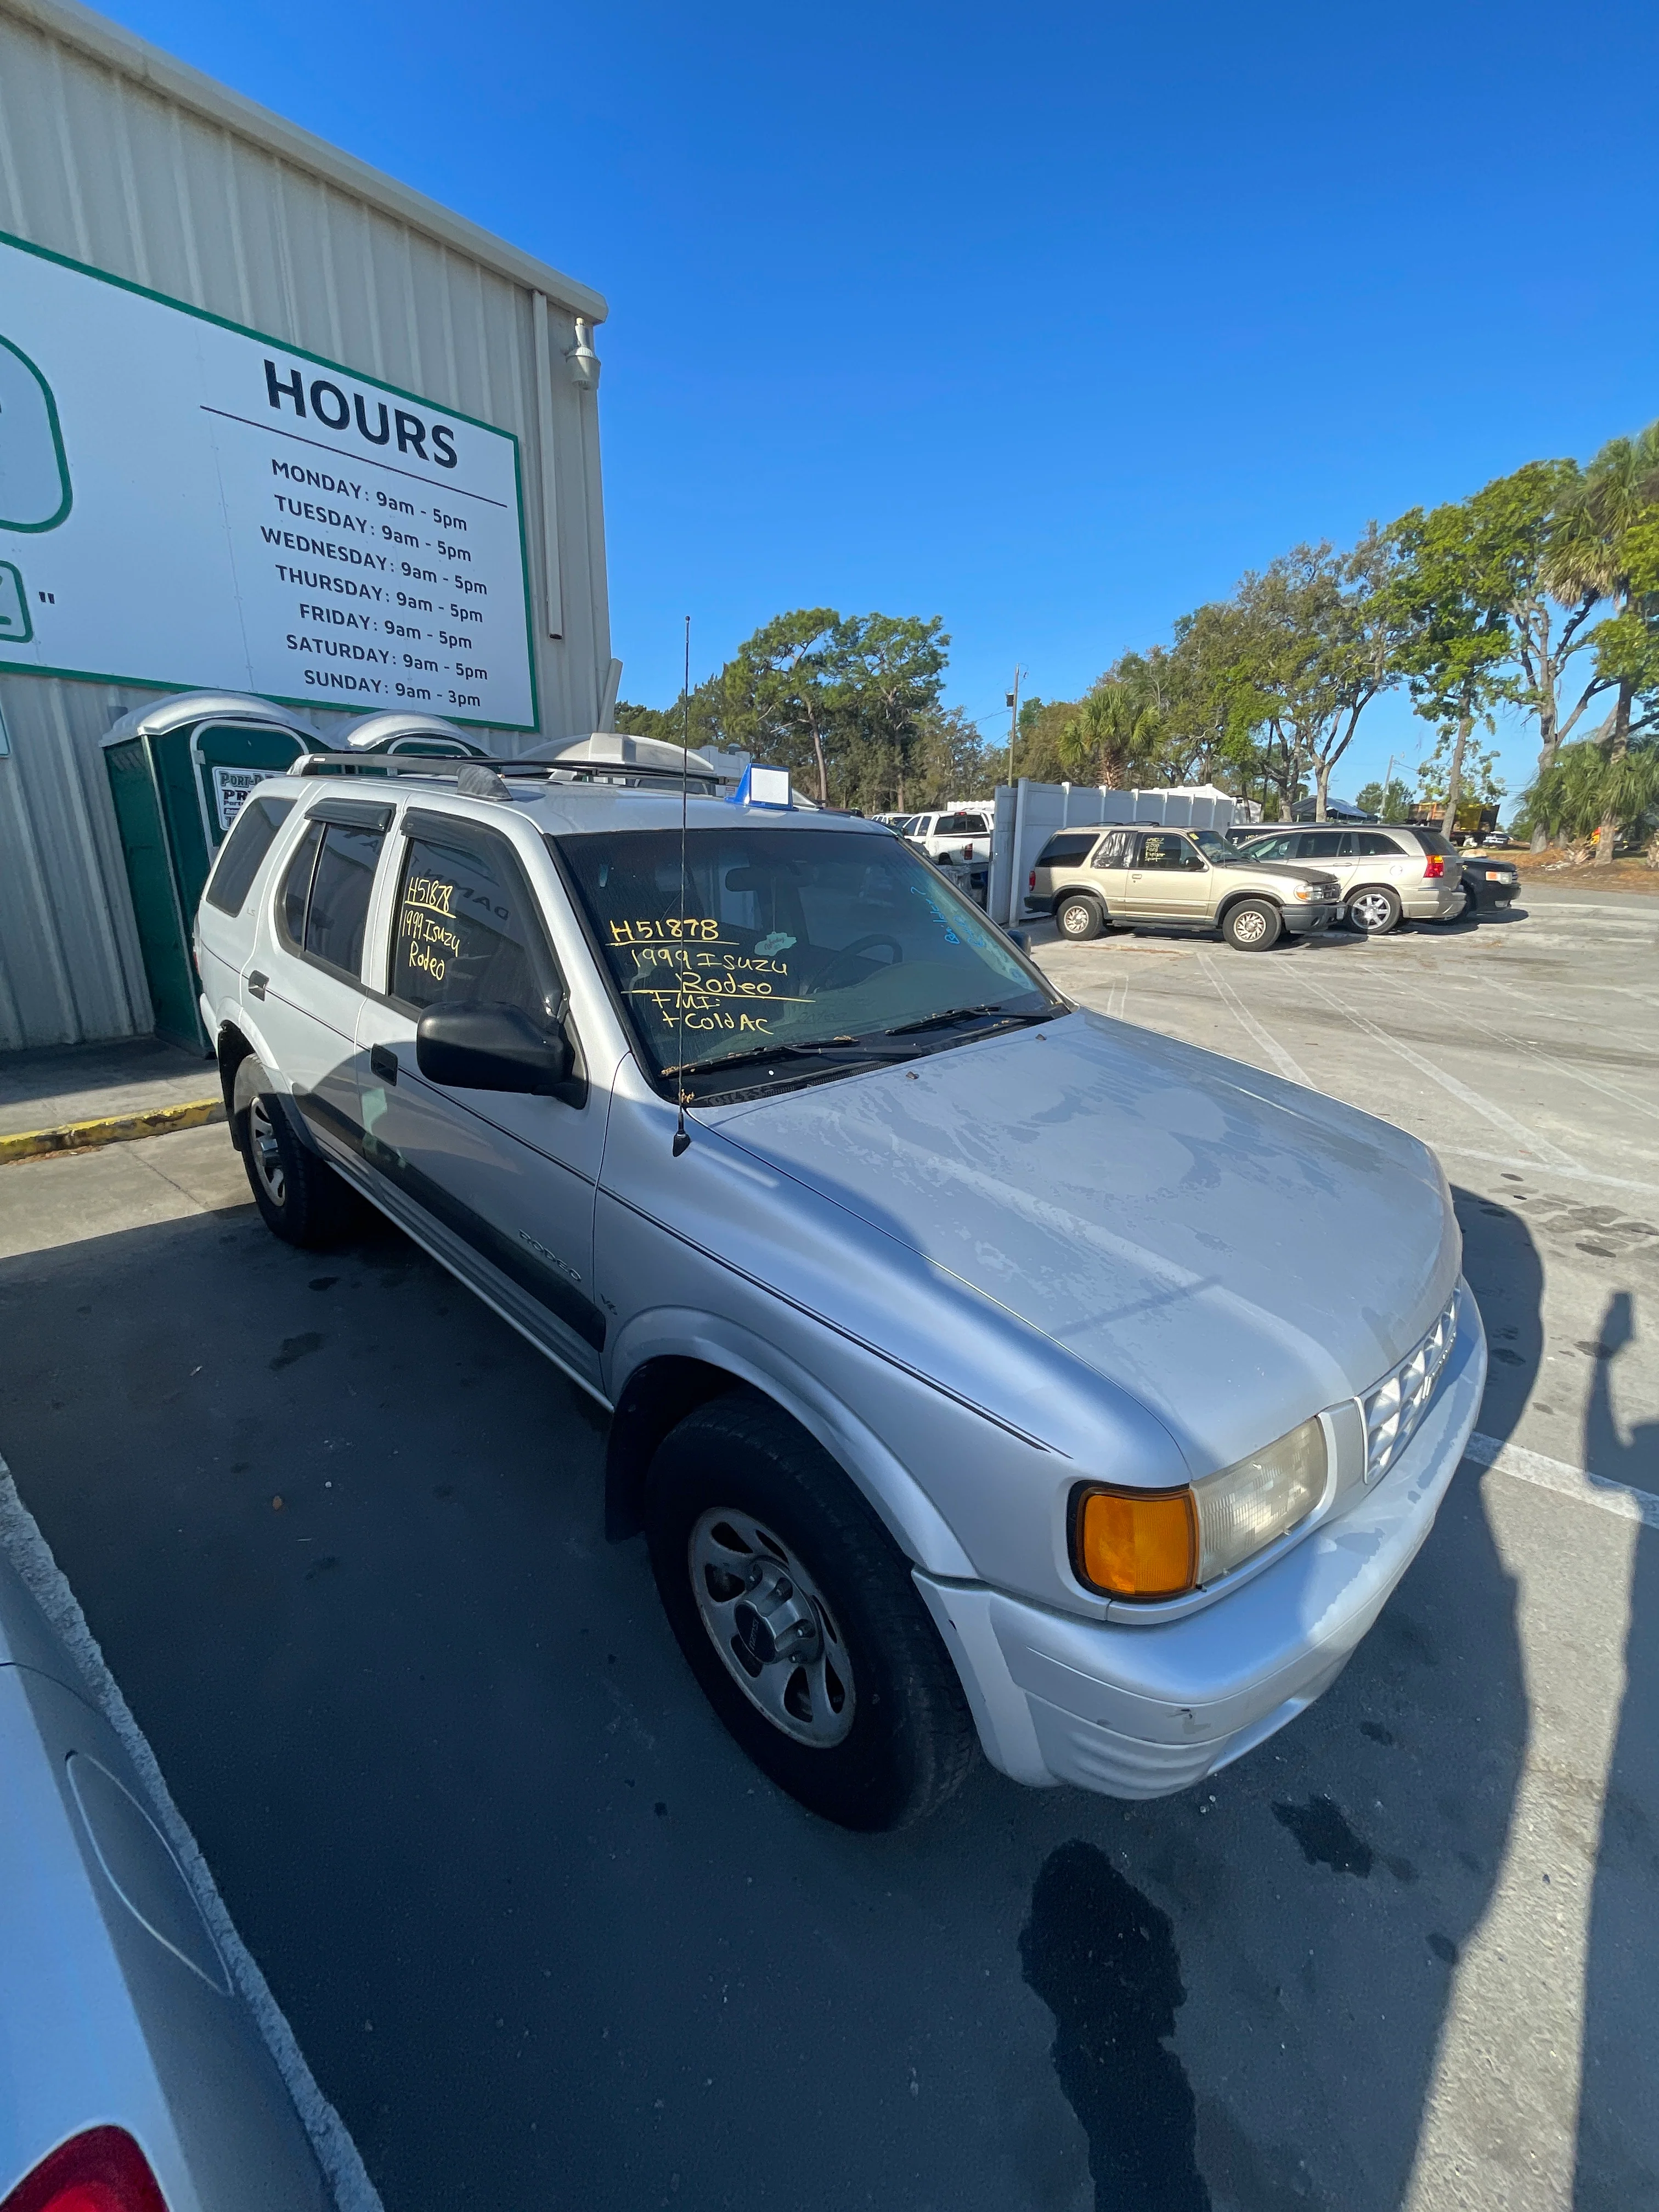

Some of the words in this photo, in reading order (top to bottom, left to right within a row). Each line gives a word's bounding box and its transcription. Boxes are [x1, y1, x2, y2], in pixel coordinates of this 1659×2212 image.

[263, 359, 458, 469] HOURS
[272, 459, 369, 501] MONDAY:
[376, 492, 414, 516] 9am
[433, 509, 467, 531] 5pm
[274, 494, 375, 536] TUESDAY:
[382, 525, 419, 548] 9am
[437, 540, 471, 562] 5pm
[260, 526, 394, 573] WEDNESDAY:
[401, 562, 437, 583] 9am
[454, 575, 487, 595] 5pm
[275, 564, 390, 602] THURSDAY:
[396, 591, 432, 612] 9am
[450, 603, 483, 623] 5pm
[300, 603, 377, 631] FRIDAY:
[384, 620, 421, 640] 9am
[439, 631, 472, 650] 5pm
[286, 634, 396, 665] SATURDAY:
[403, 654, 438, 673] 9am
[455, 663, 488, 680] 5pm
[304, 669, 388, 694] SUNDAY:
[395, 682, 431, 701] 9am
[448, 690, 481, 707] 3pm
[407, 877, 454, 913] H51878
[402, 910, 424, 940] 1999
[610, 919, 719, 941] H51878
[409, 940, 445, 981] Rodeo
[631, 948, 693, 970] 1999
[675, 971, 772, 995] Rodeo
[685, 1013, 735, 1030] Cold
[741, 1013, 775, 1035] AC
